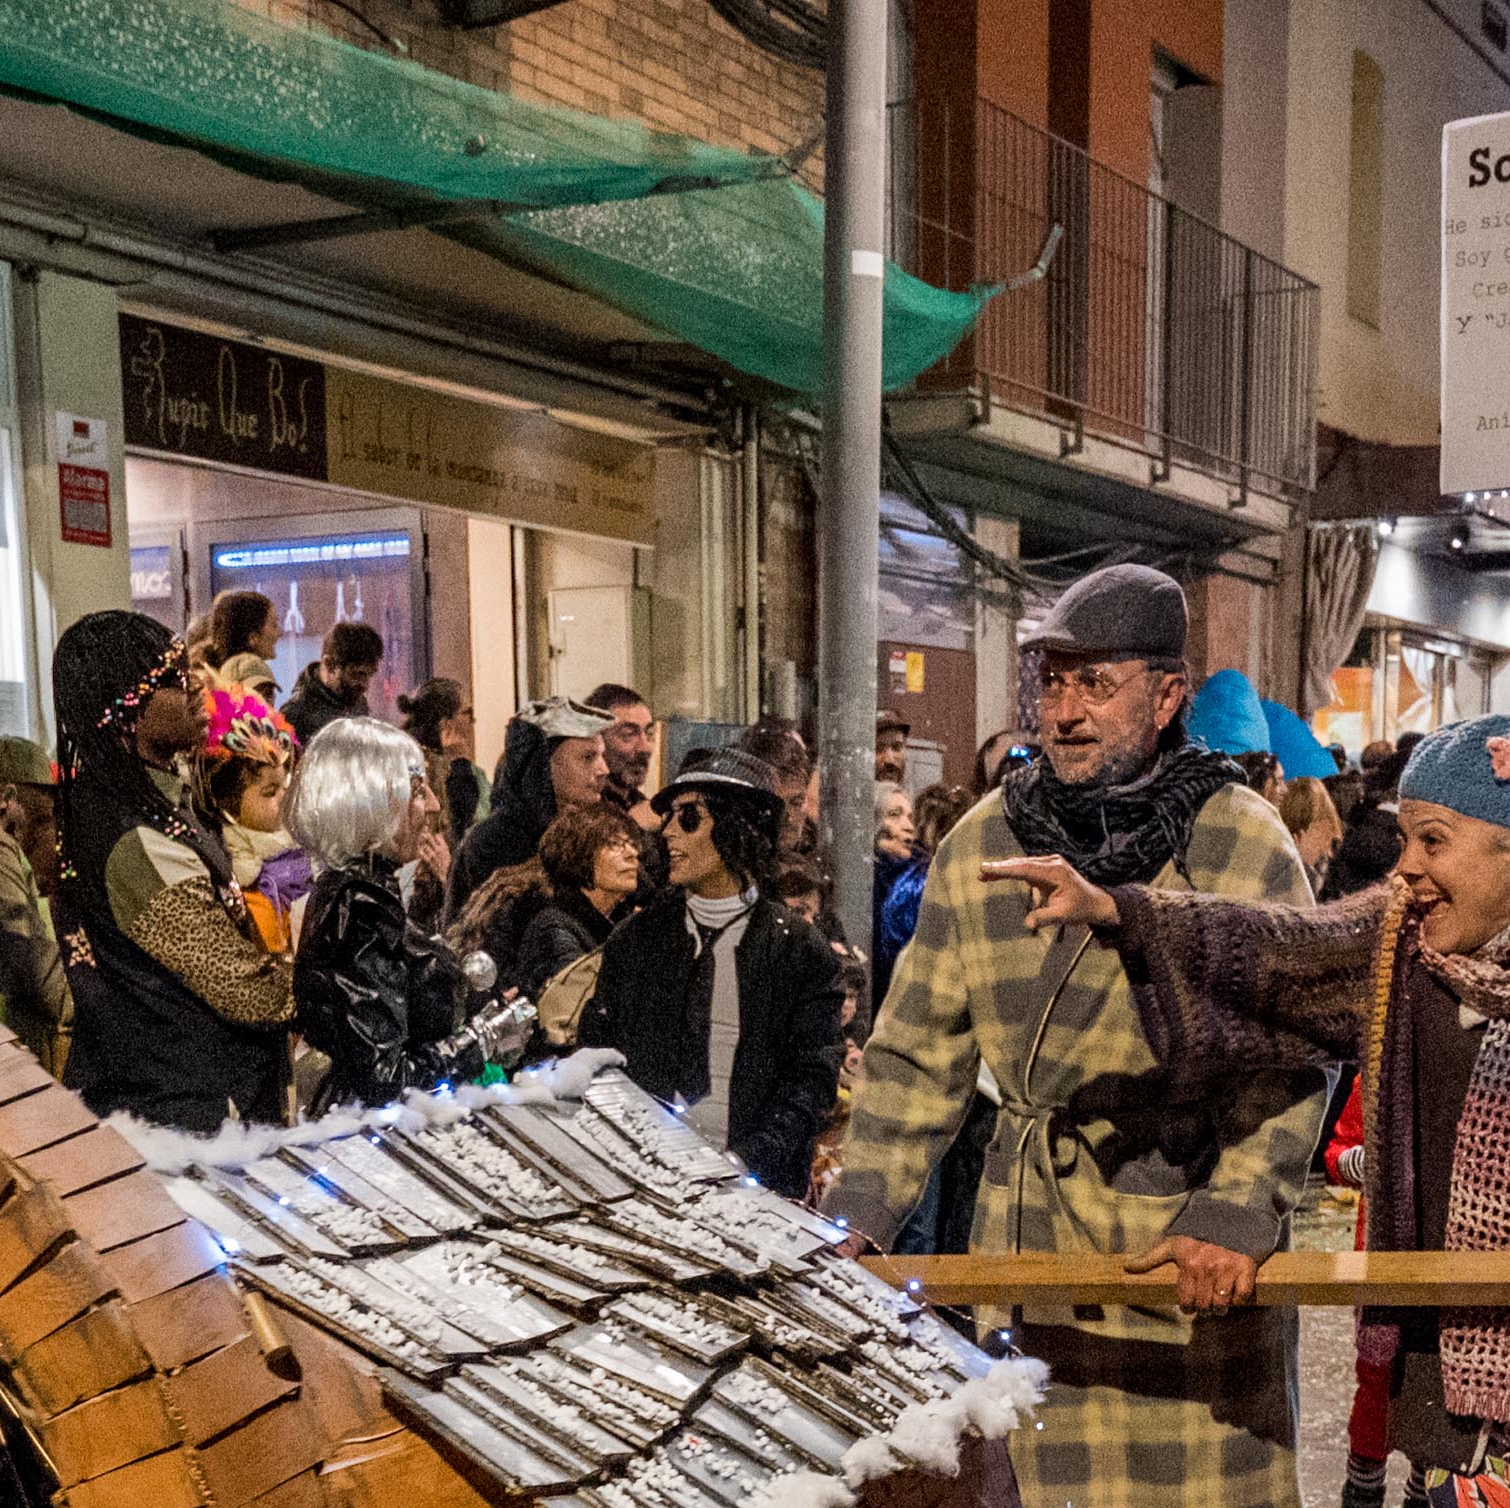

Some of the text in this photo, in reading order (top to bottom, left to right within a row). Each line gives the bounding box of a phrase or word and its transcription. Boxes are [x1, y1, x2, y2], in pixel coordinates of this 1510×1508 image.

[1455, 249, 1492, 268] Soy
[1456, 315, 1473, 335] y
[218, 345, 259, 447] Que
